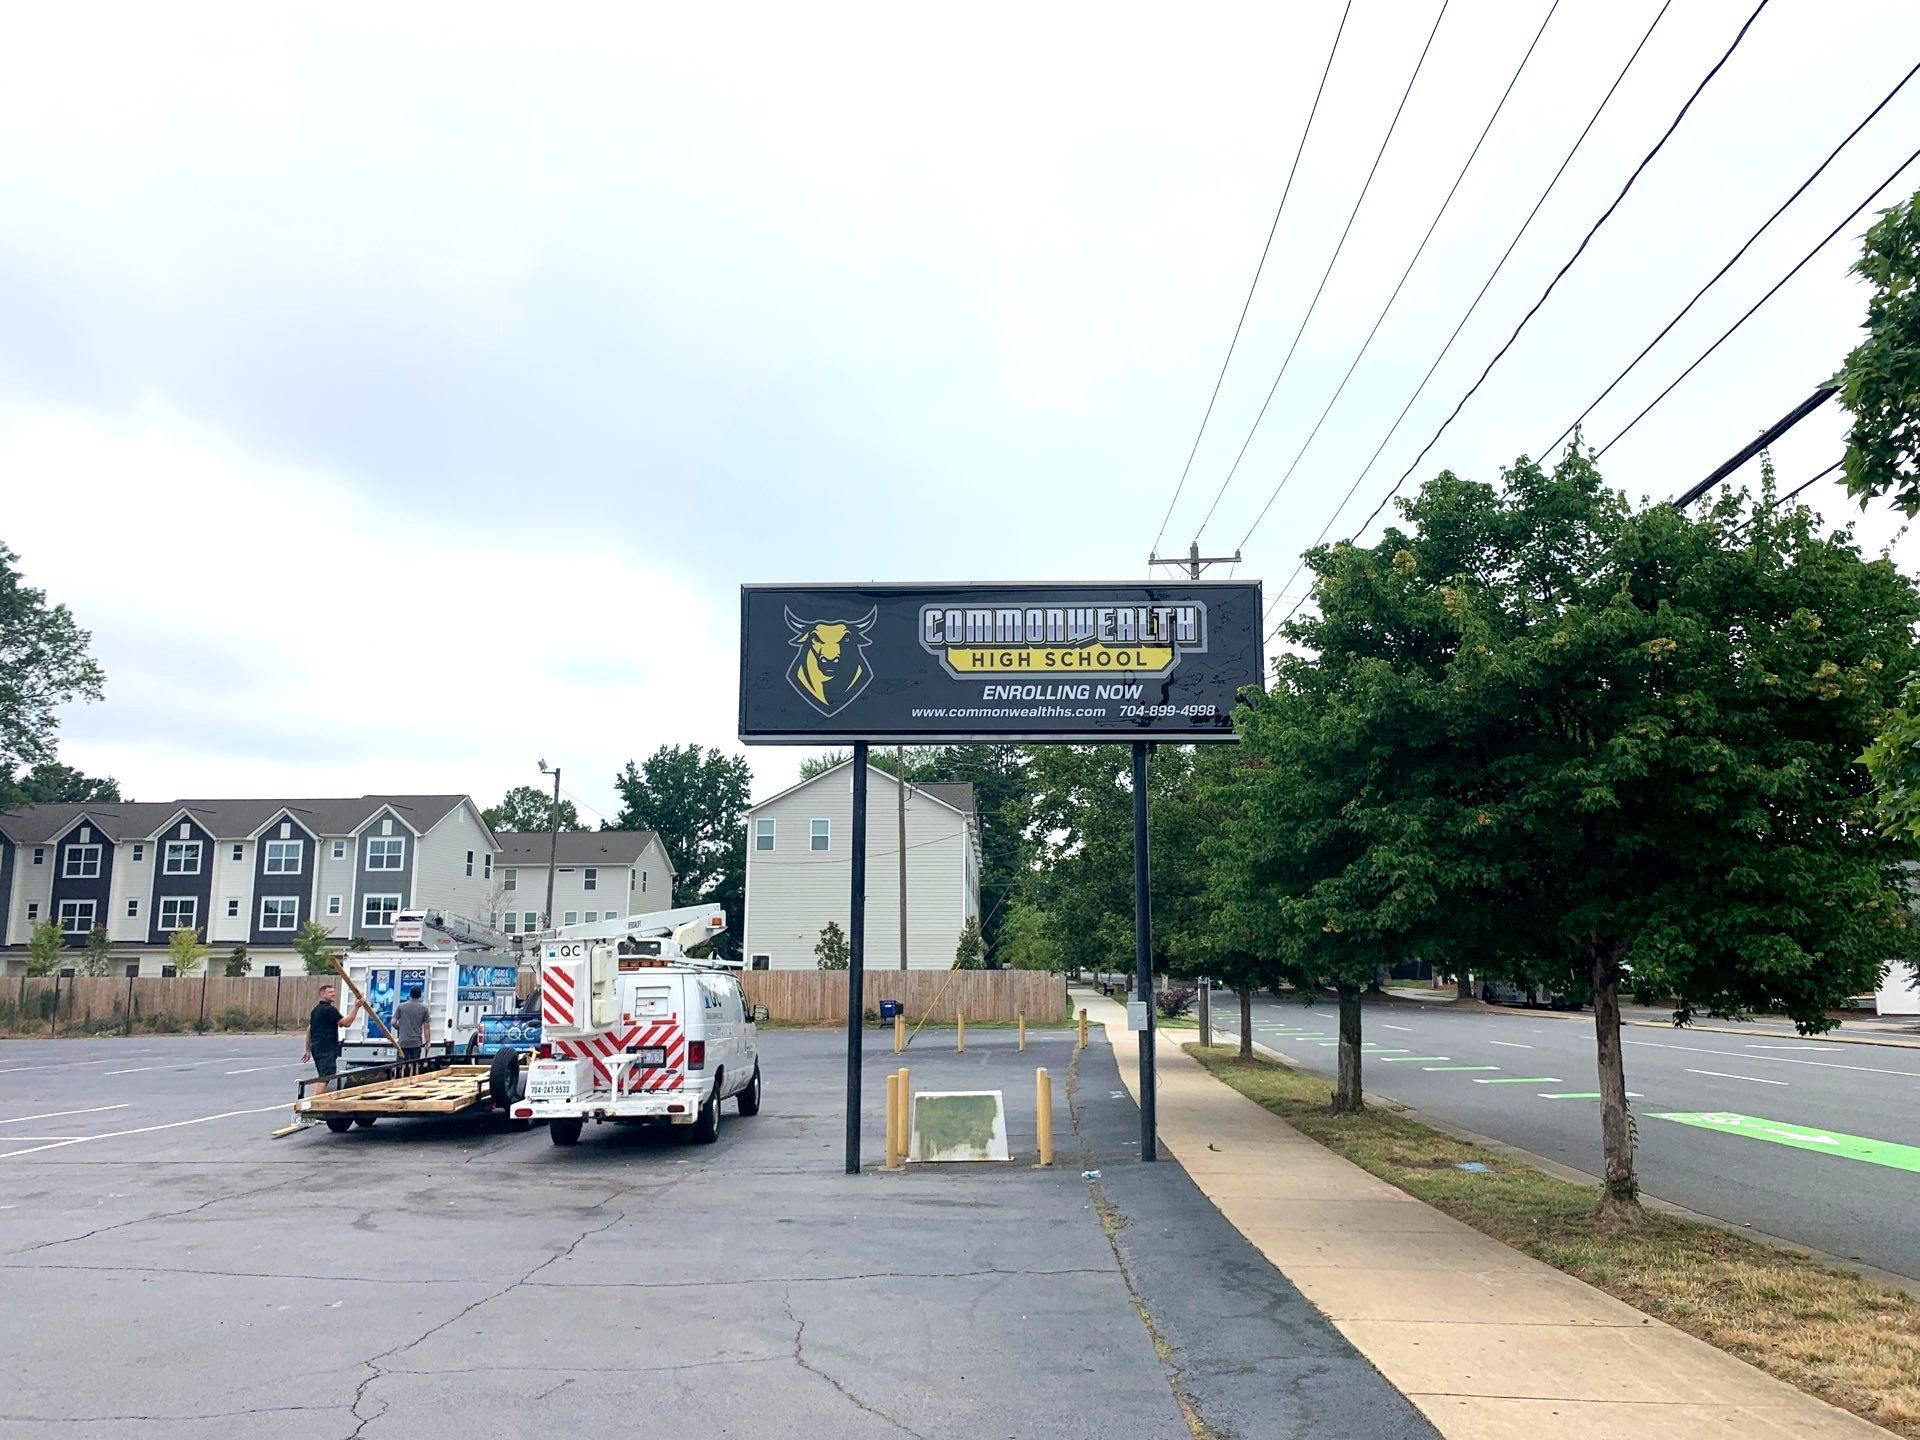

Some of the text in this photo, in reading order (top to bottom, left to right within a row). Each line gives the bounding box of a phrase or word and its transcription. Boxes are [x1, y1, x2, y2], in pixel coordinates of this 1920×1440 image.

[924, 606, 1197, 644] COMMONWEALTH
[972, 651, 1148, 667] HIGH SCHOOL
[982, 684, 1143, 700] ENROLLING NOW
[911, 704, 1216, 718] www.commonwealthhs.com 704-899-4998
[560, 945, 580, 957] QC
[411, 970, 425, 978] QC
[477, 967, 492, 986] QC
[507, 1026, 536, 1041] QC
